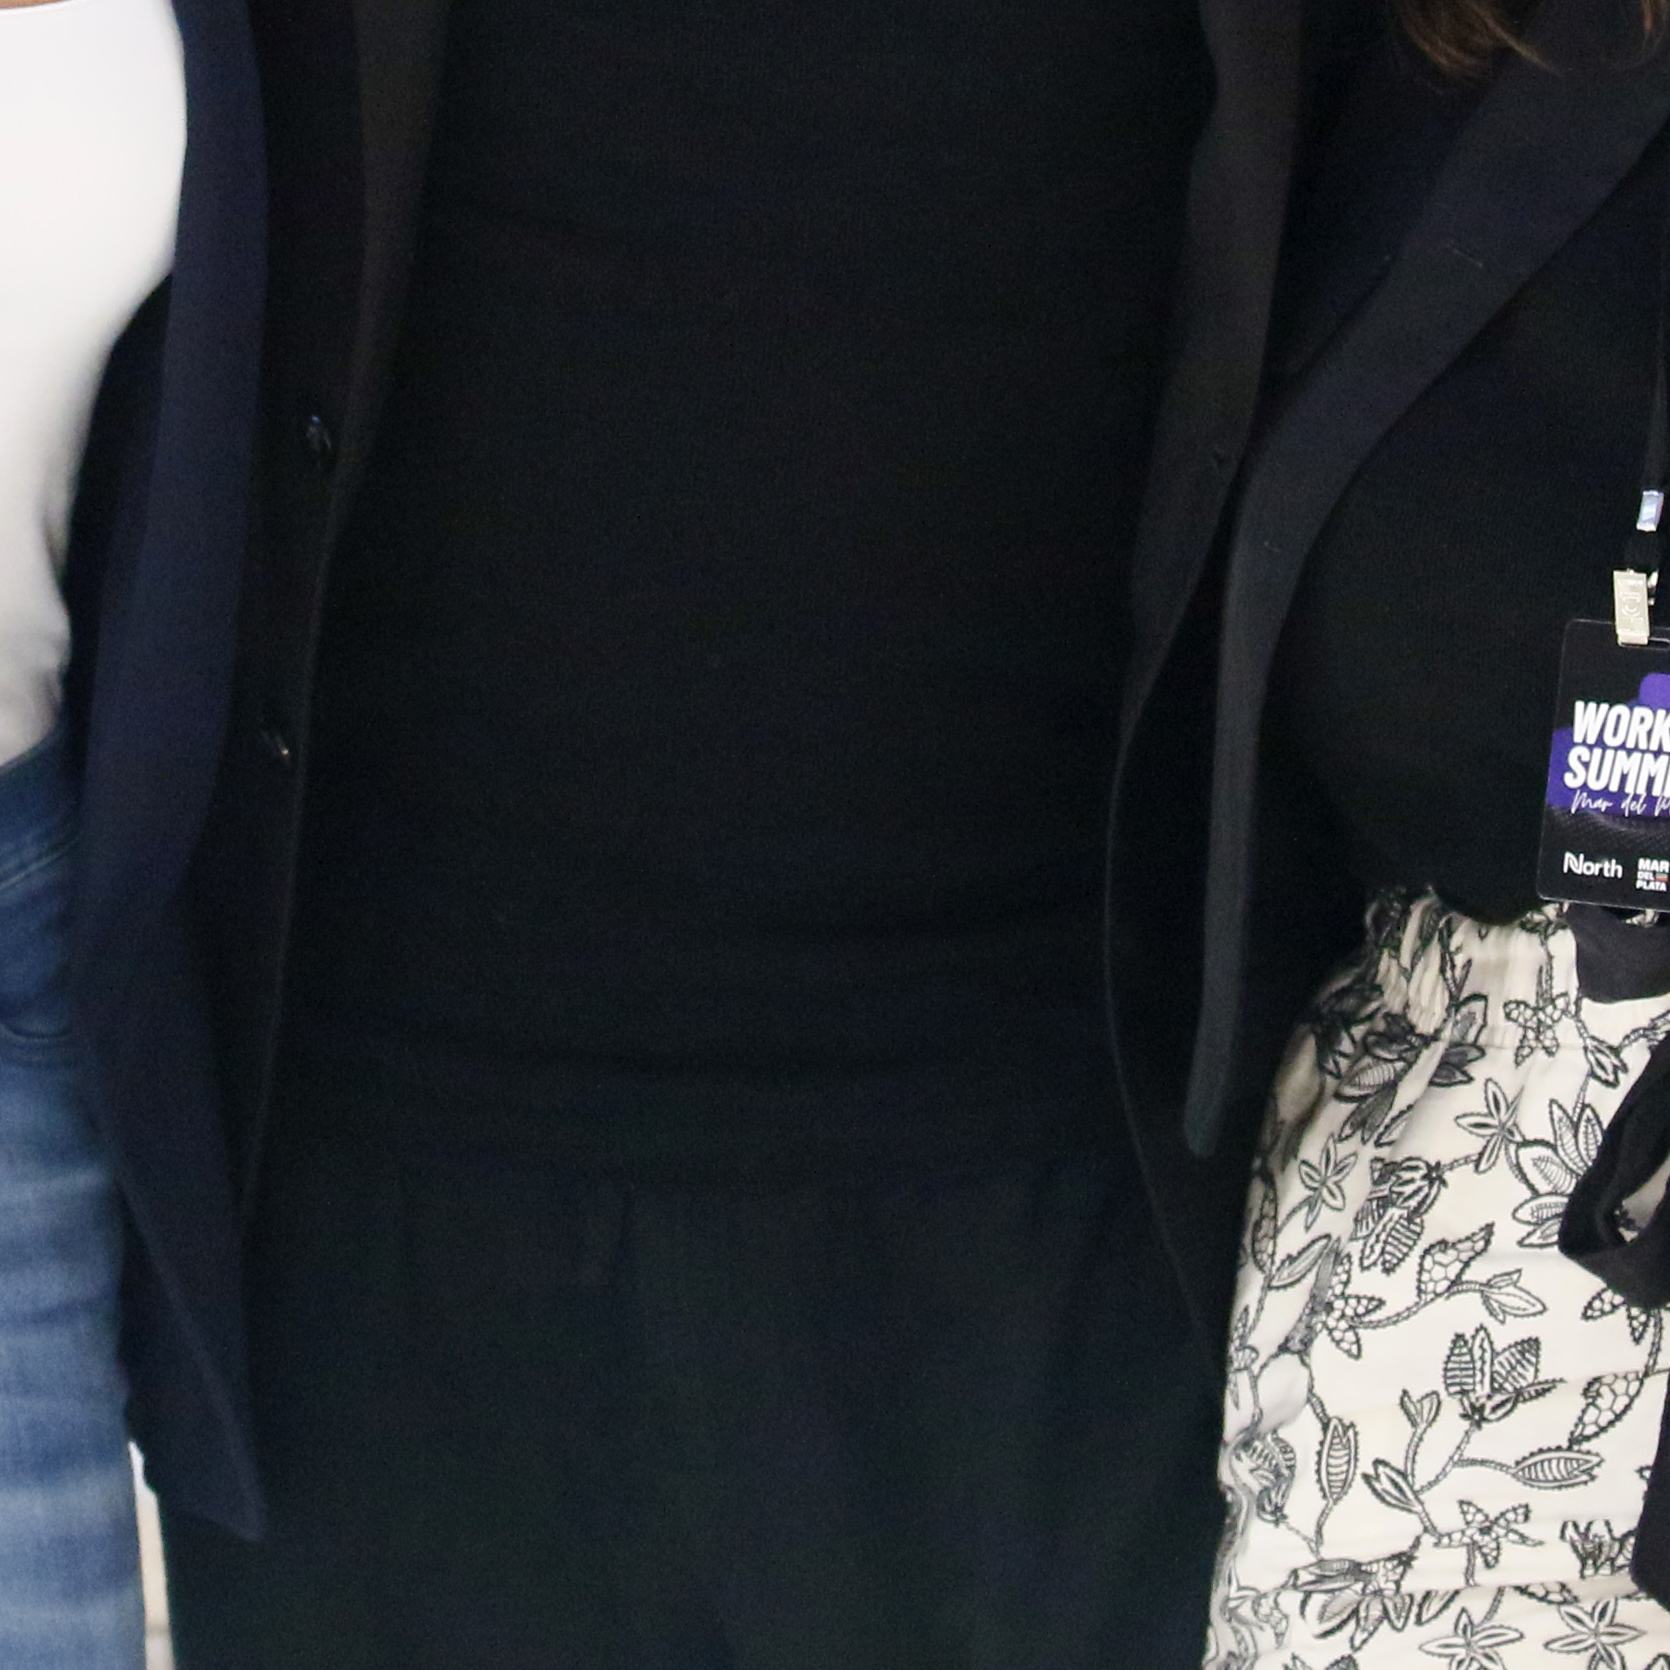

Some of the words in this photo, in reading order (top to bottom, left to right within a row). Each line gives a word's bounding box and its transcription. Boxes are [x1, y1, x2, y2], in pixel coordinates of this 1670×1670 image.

[1571, 790, 1613, 814] Mar
[1620, 792, 1647, 817] del
[1563, 851, 1624, 879] North
[1638, 858, 1670, 874] MAR
[1637, 871, 1655, 881] DEL
[1636, 880, 1668, 892] PLATA
